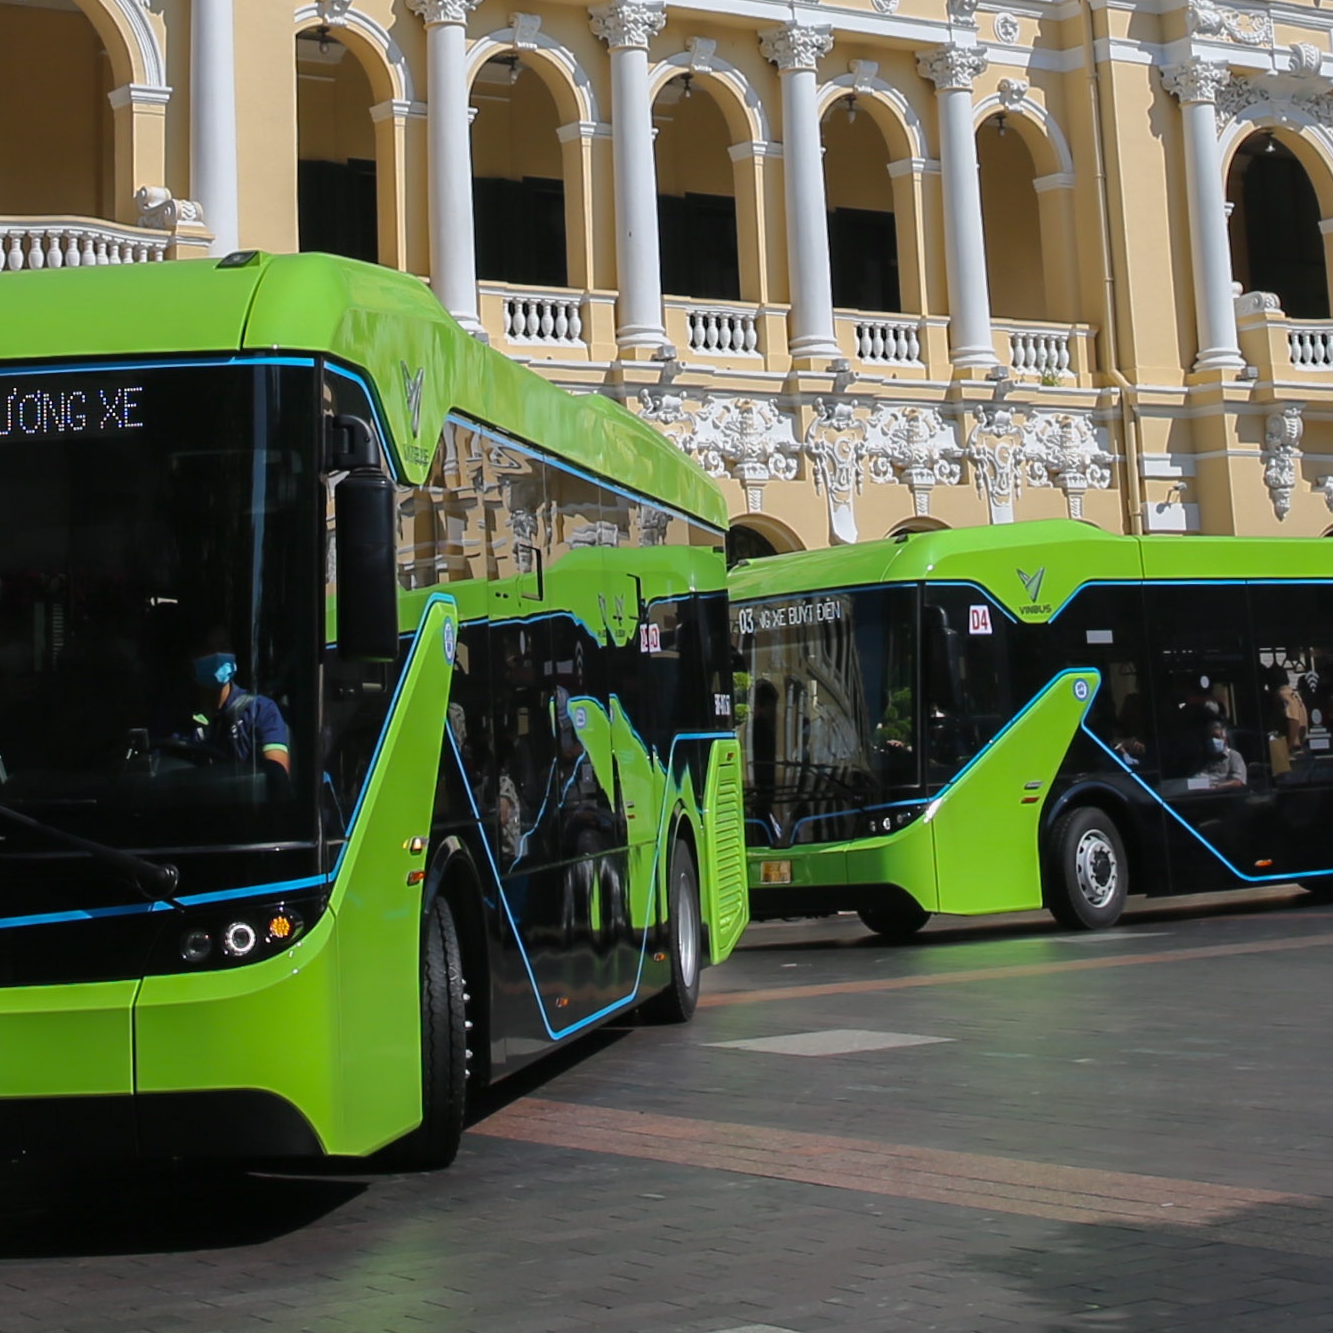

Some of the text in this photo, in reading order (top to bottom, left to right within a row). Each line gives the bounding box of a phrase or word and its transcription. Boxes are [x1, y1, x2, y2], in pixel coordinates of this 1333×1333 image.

[99, 386, 144, 430] XE
[738, 607, 754, 635] 03
[772, 607, 787, 628] XE
[971, 609, 989, 631] D4
